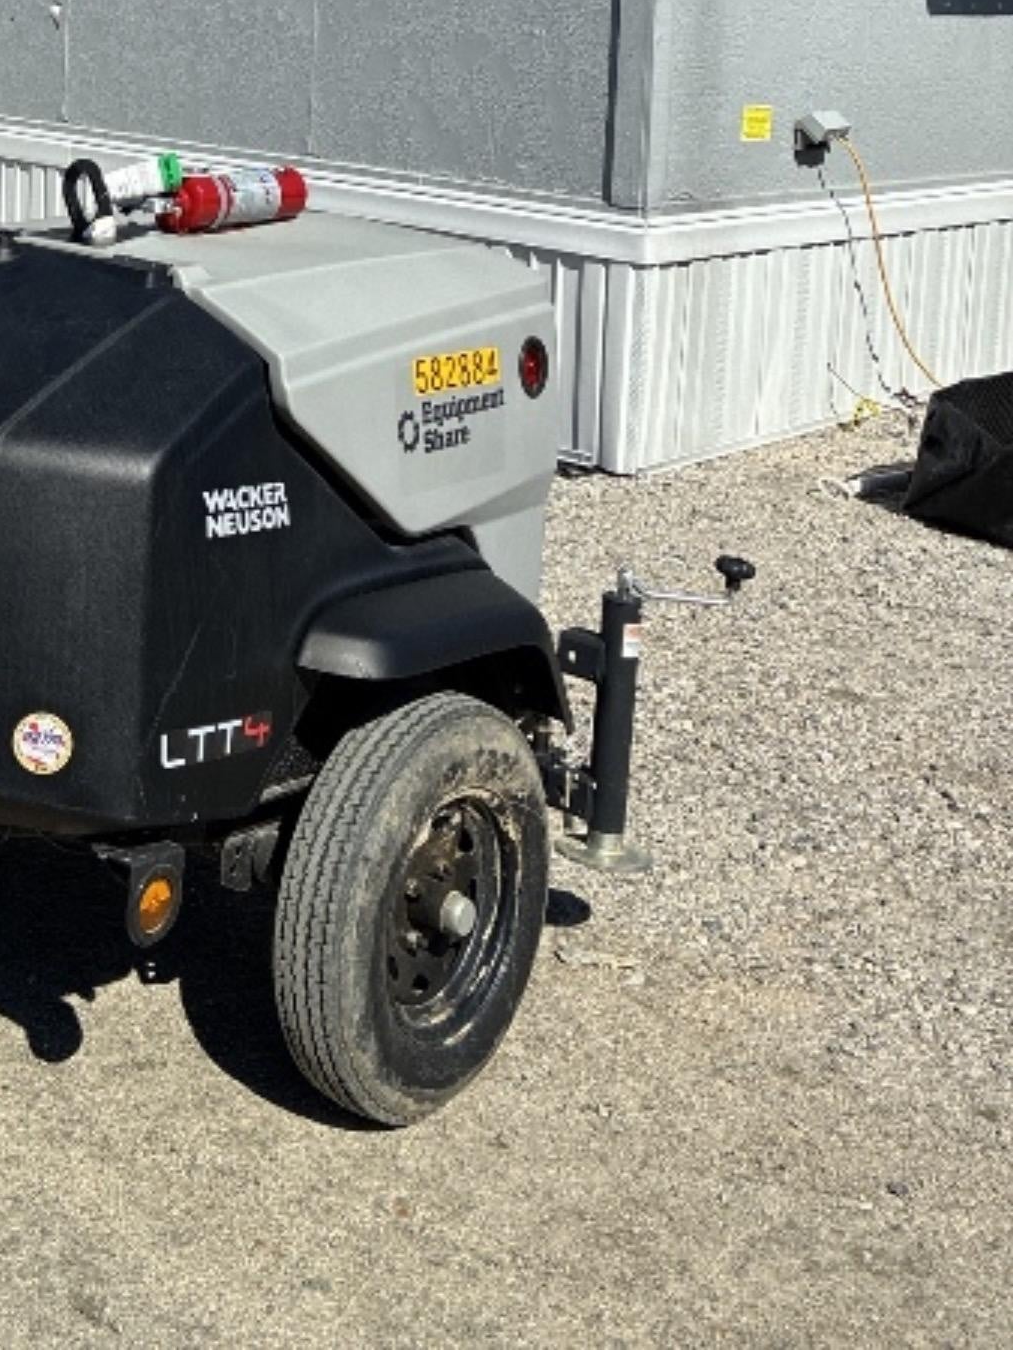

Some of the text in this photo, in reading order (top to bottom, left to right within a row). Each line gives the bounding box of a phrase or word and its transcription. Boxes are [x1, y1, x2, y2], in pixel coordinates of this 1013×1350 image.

[415, 349, 499, 394] 582884
[421, 387, 506, 426] Equipment
[423, 425, 472, 454] Share
[202, 481, 288, 514] WACKER
[205, 503, 291, 540] NEUSON
